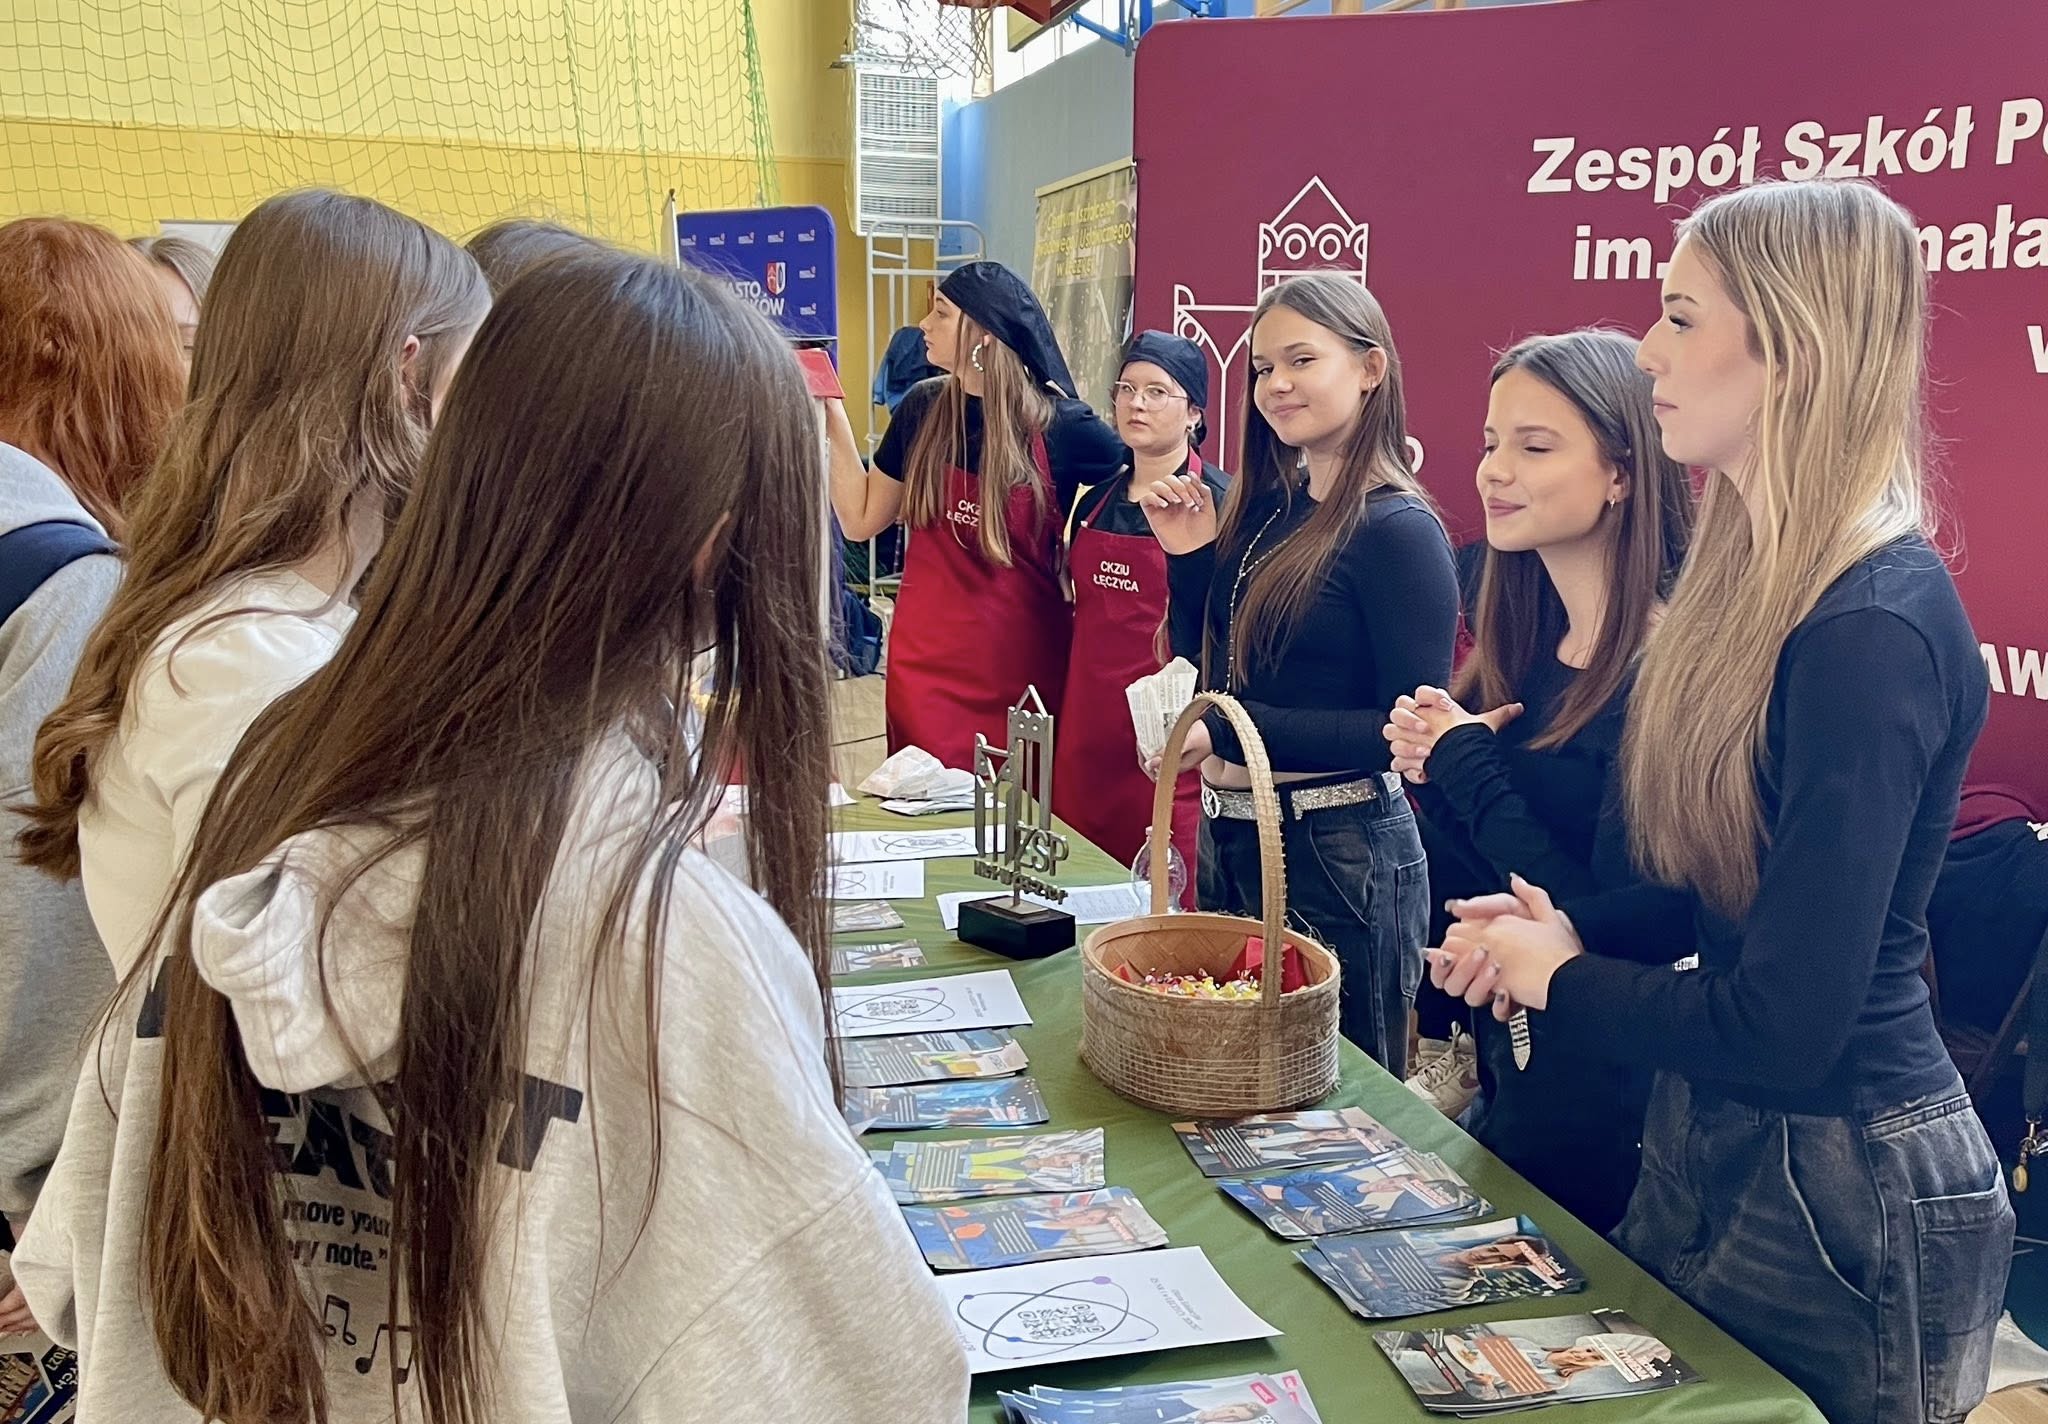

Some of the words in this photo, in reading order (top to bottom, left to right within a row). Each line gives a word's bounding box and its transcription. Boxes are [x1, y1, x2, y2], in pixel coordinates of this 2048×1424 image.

[1527, 126, 1761, 203] Zespół
[1780, 106, 1975, 182] Szkół
[1996, 97, 2048, 165] P
[1573, 225, 1671, 281] im.
[1093, 573, 1139, 593] ŁĘCZYCA
